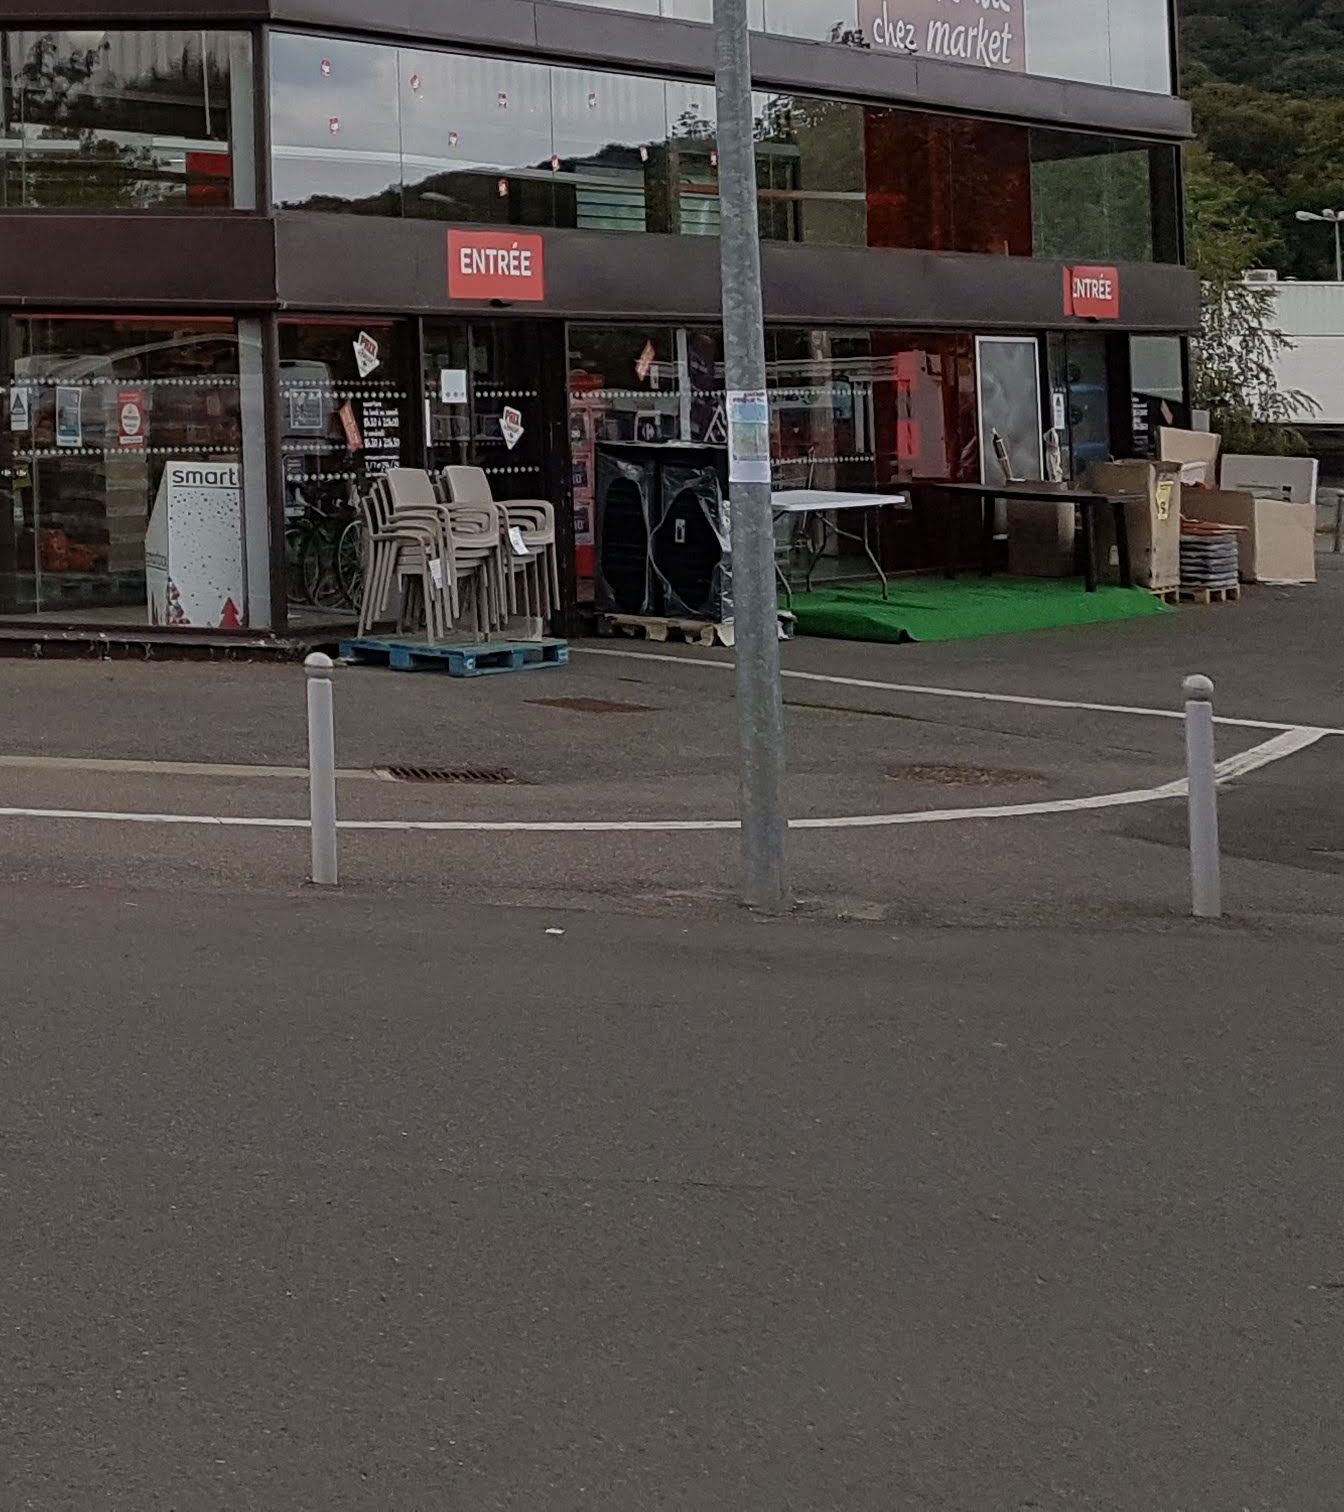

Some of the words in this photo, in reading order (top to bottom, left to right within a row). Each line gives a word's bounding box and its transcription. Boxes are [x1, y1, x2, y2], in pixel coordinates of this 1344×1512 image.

[873, 0, 917, 49] chez
[926, 17, 1012, 68] market
[460, 241, 532, 276] ENTRÉE
[172, 467, 237, 486] smart
